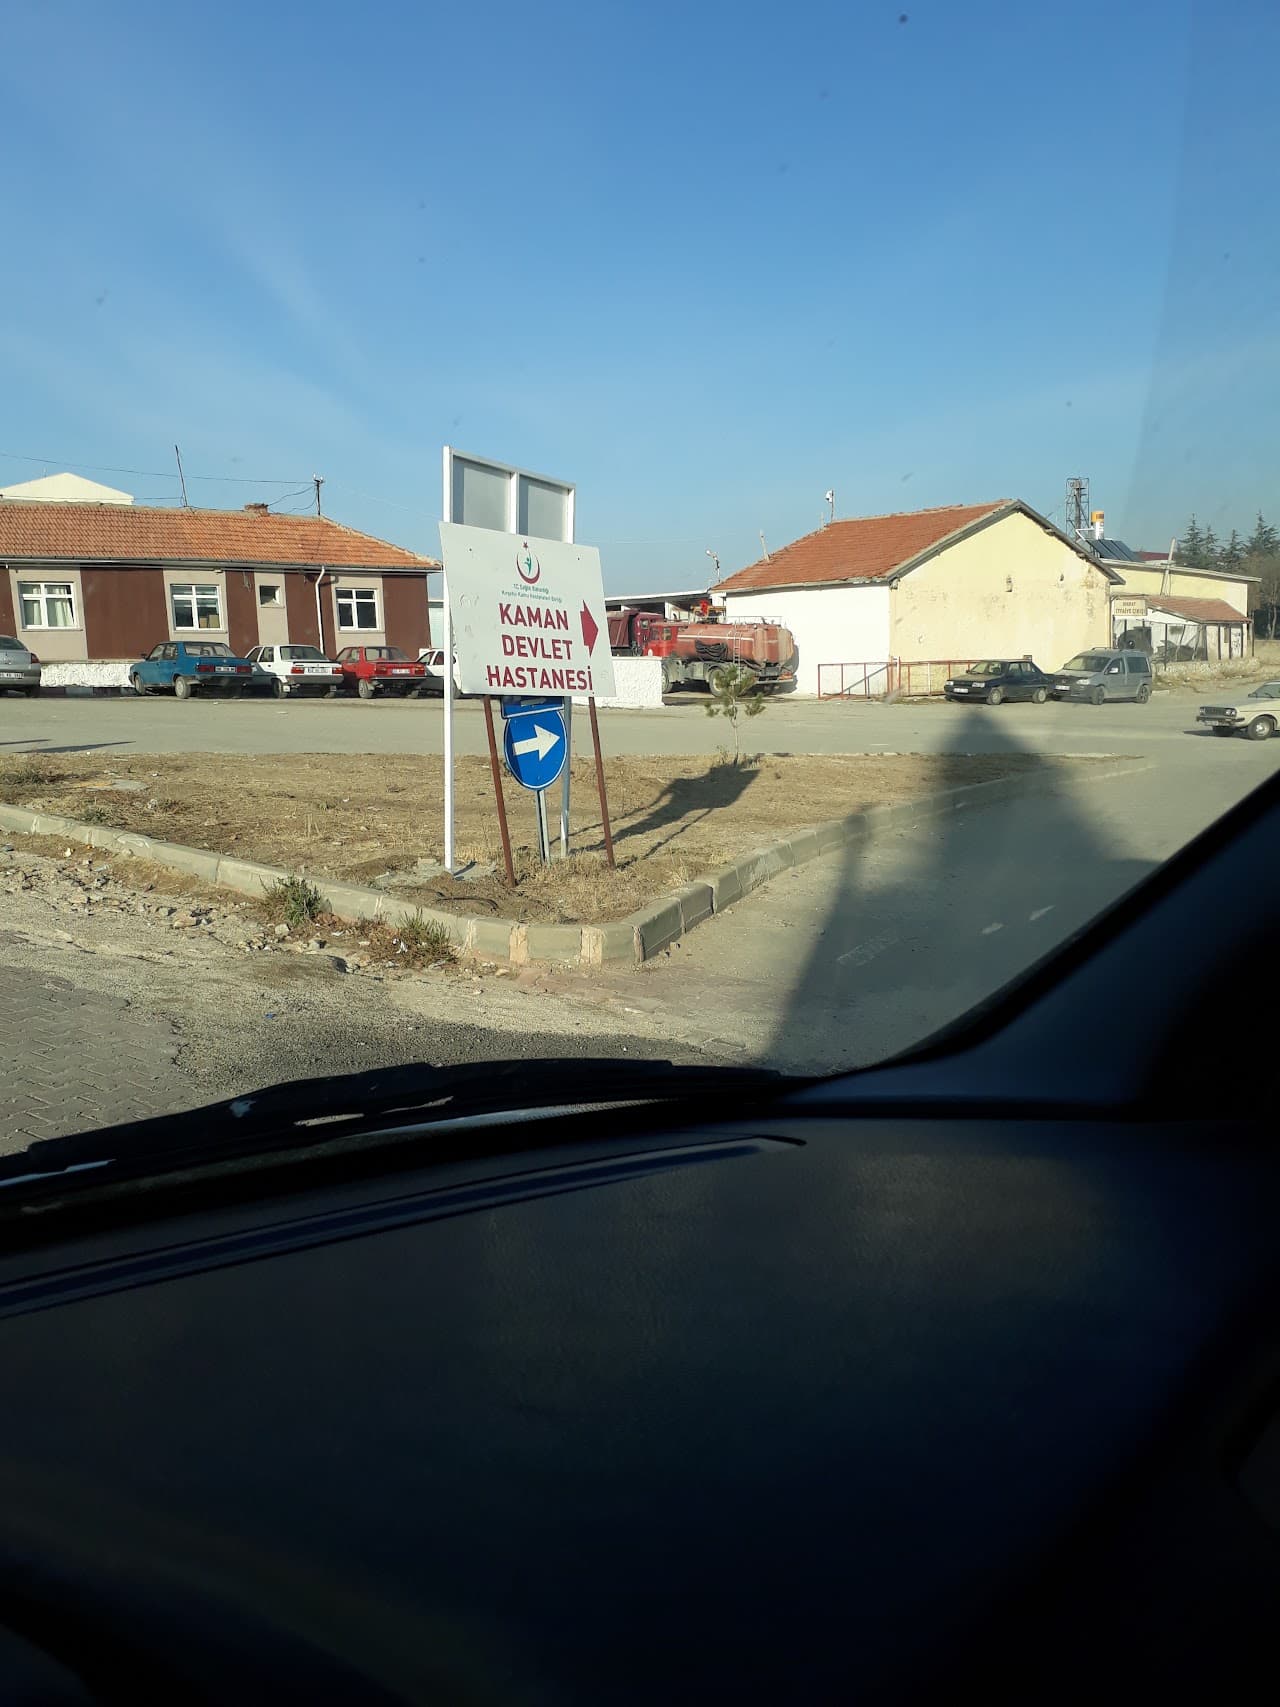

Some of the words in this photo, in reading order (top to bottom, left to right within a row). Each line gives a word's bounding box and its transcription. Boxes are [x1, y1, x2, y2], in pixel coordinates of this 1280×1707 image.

[498, 602, 569, 631] KAMAN
[501, 634, 573, 660] DEVLET
[486, 665, 593, 691] HASTANESİ
